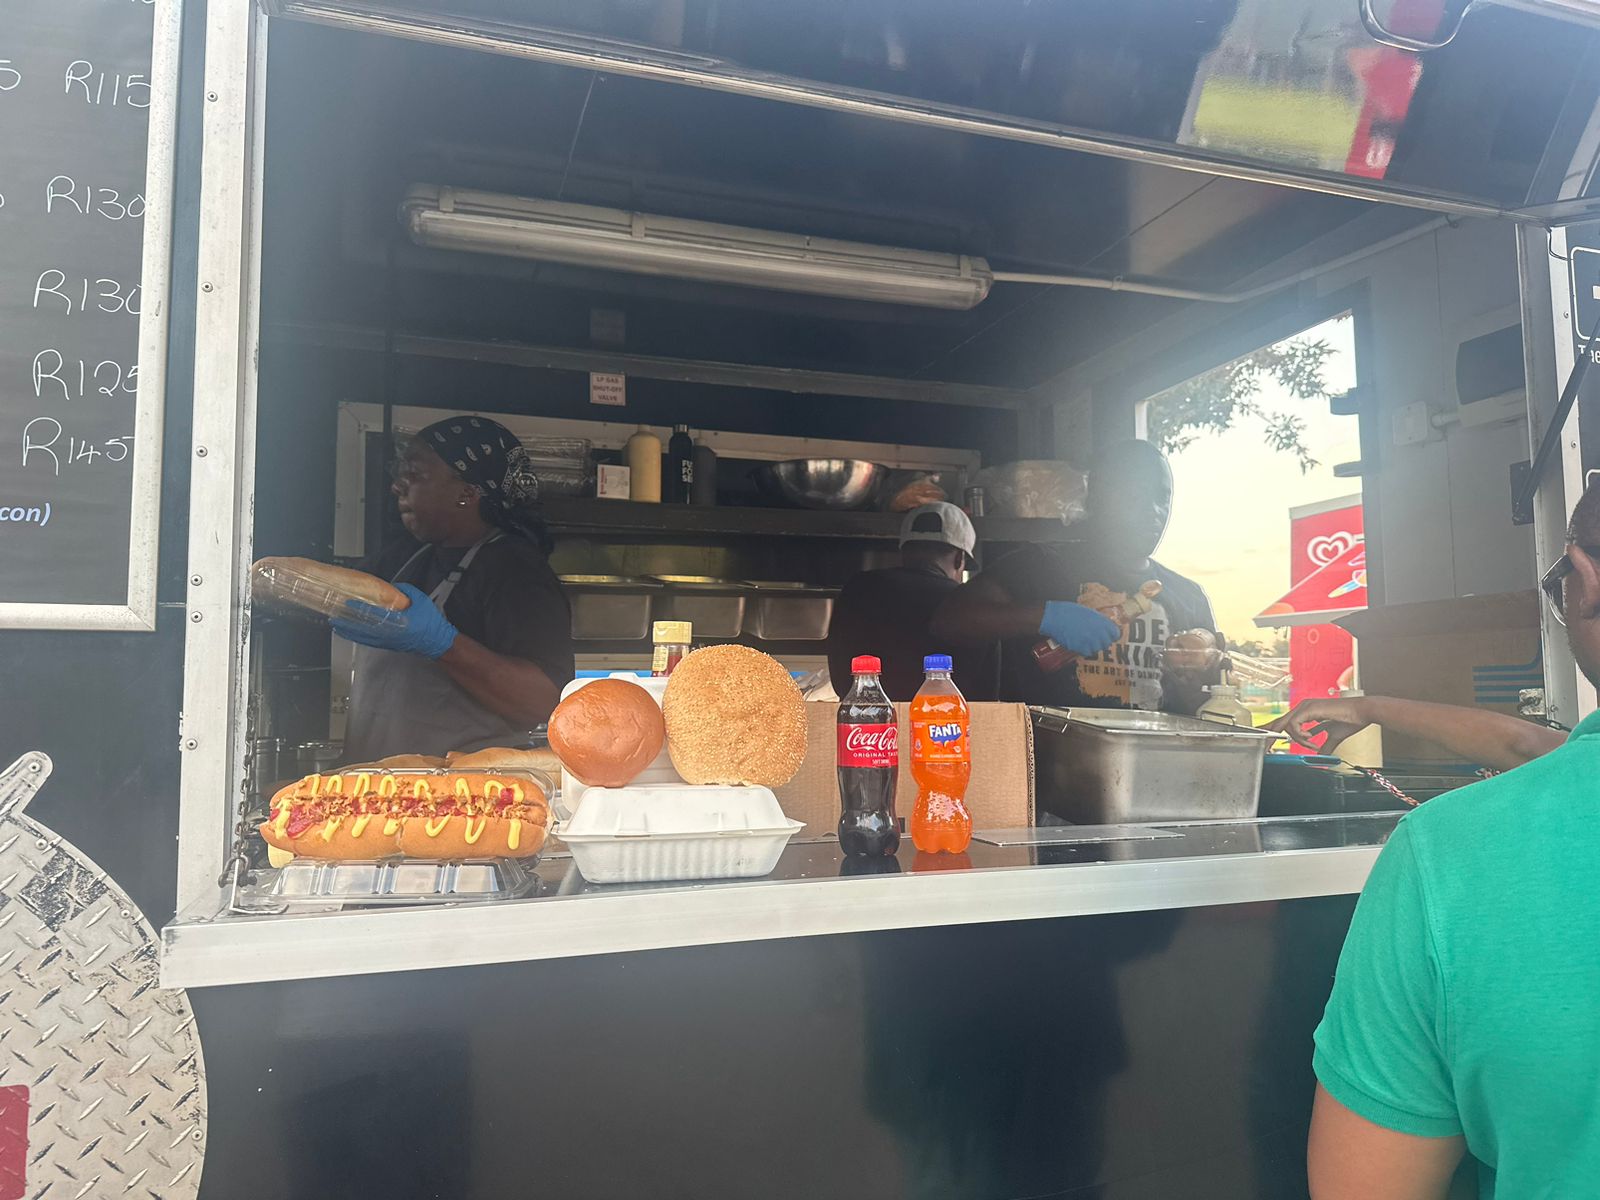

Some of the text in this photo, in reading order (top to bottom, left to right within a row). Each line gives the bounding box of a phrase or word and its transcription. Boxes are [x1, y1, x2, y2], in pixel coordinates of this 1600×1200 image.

[65, 60, 152, 108] R115
[47, 175, 146, 220] R130
[33, 269, 143, 316] R130
[32, 348, 139, 401] R125
[22, 416, 136, 476] R145
[1083, 665, 1100, 674] THE
[1103, 666, 1121, 676] ART
[846, 727, 898, 751] Coca-Col
[928, 723, 962, 738] FANTA
